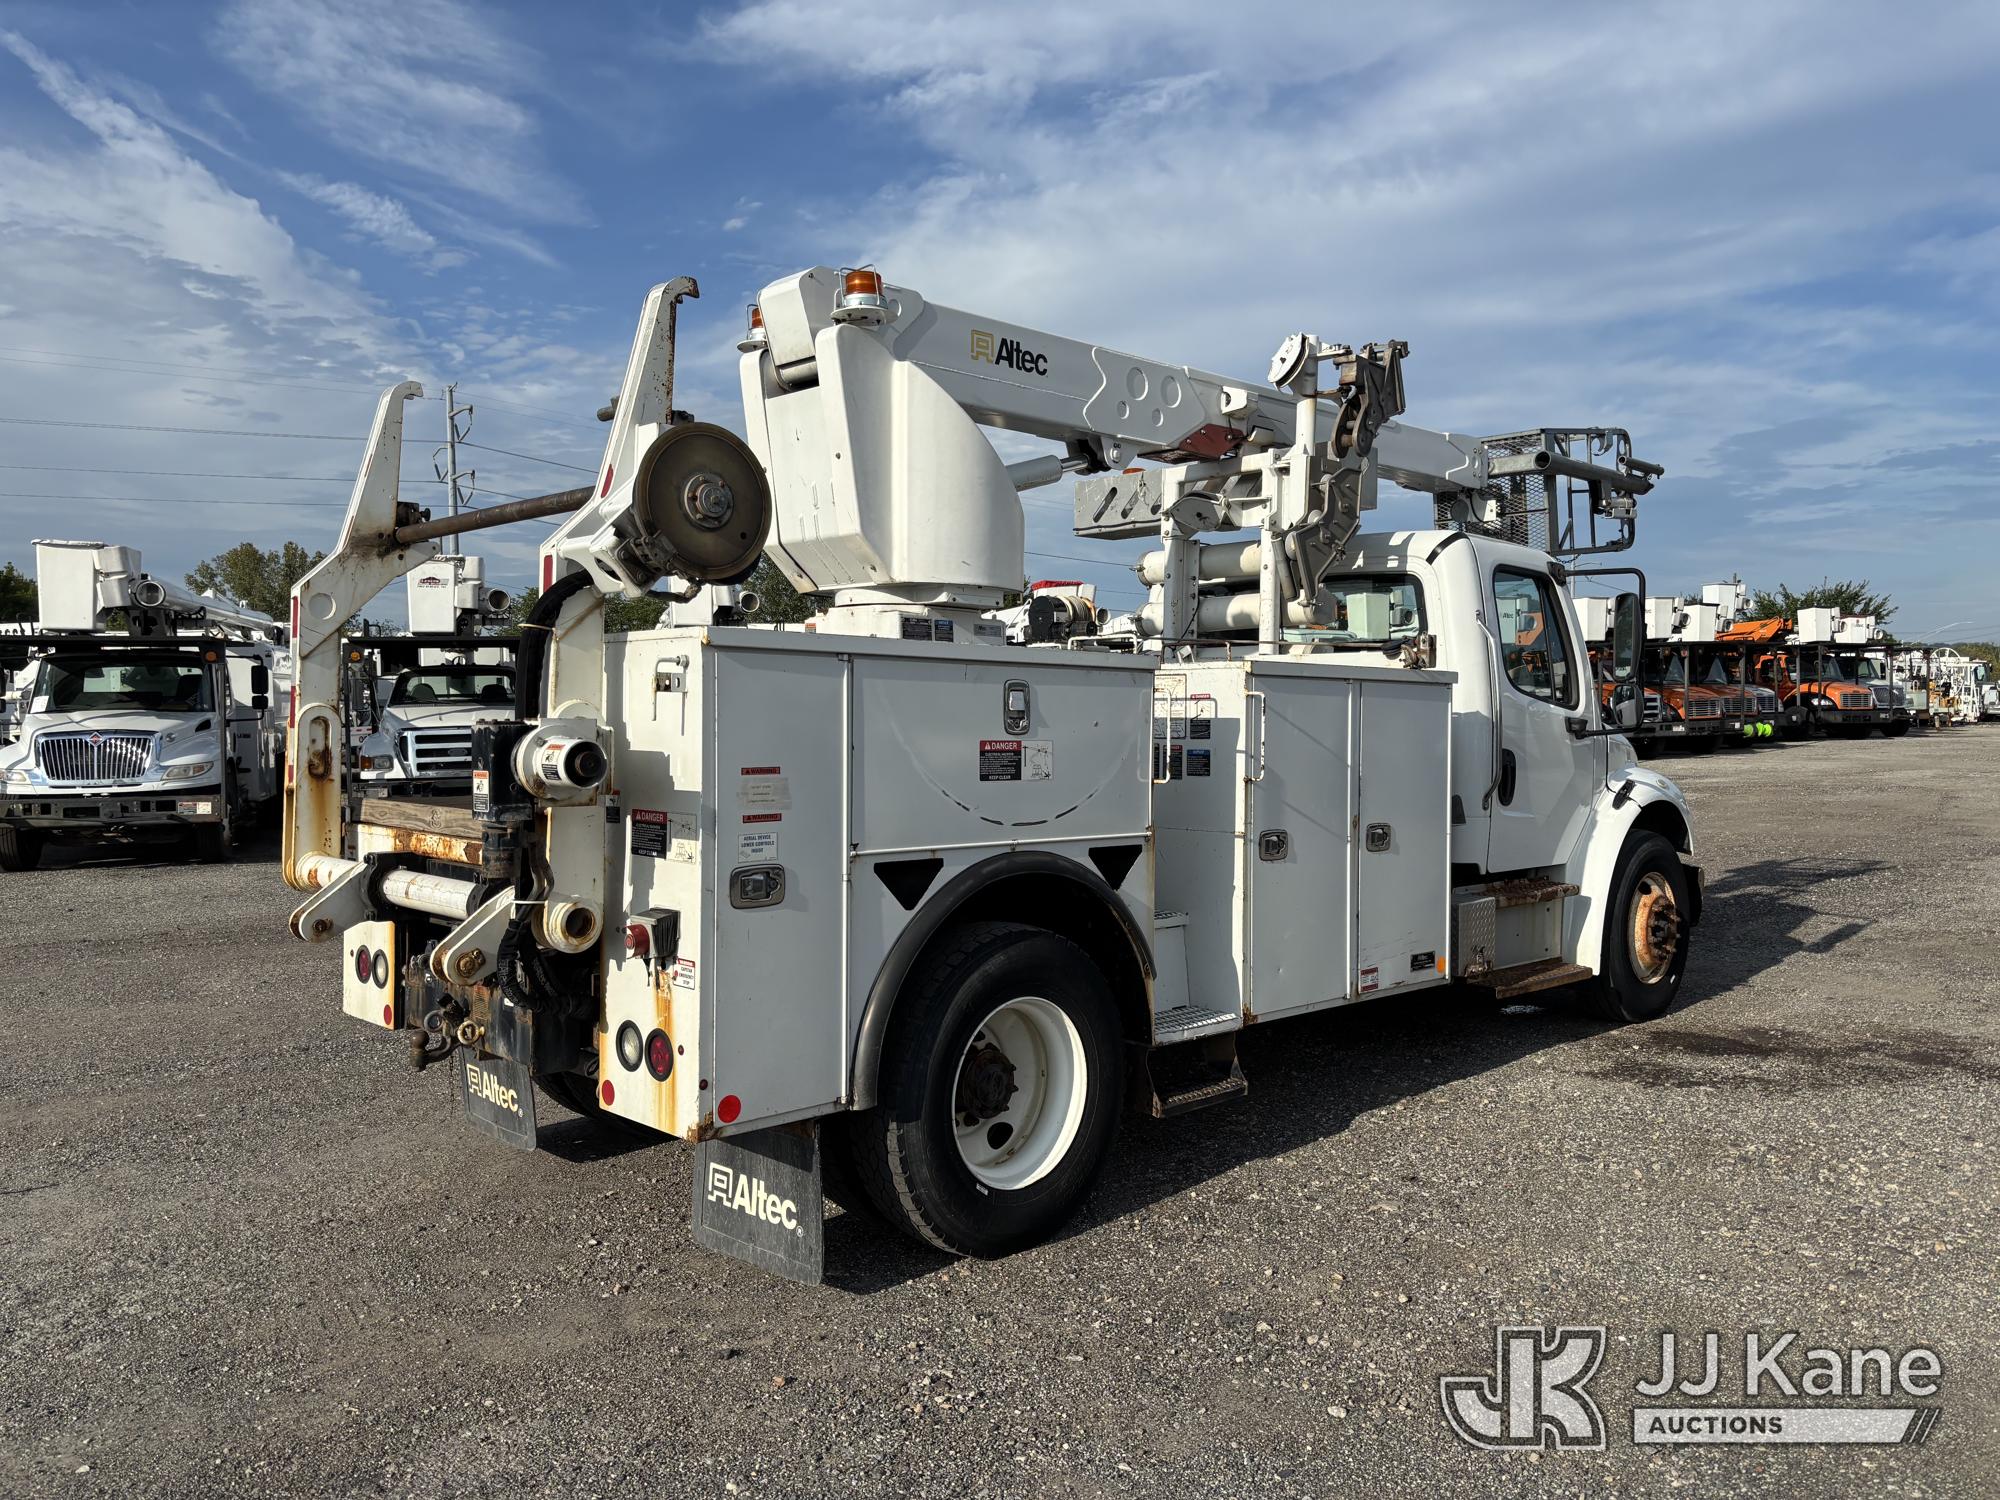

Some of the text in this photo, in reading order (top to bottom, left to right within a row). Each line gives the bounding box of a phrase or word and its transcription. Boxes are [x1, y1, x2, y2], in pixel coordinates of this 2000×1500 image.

[995, 337, 1048, 377] Altec
[991, 742, 1018, 750] DANGER
[641, 812, 664, 822] DANGER
[482, 1071, 519, 1112] Altec
[732, 1173, 798, 1230] Altec
